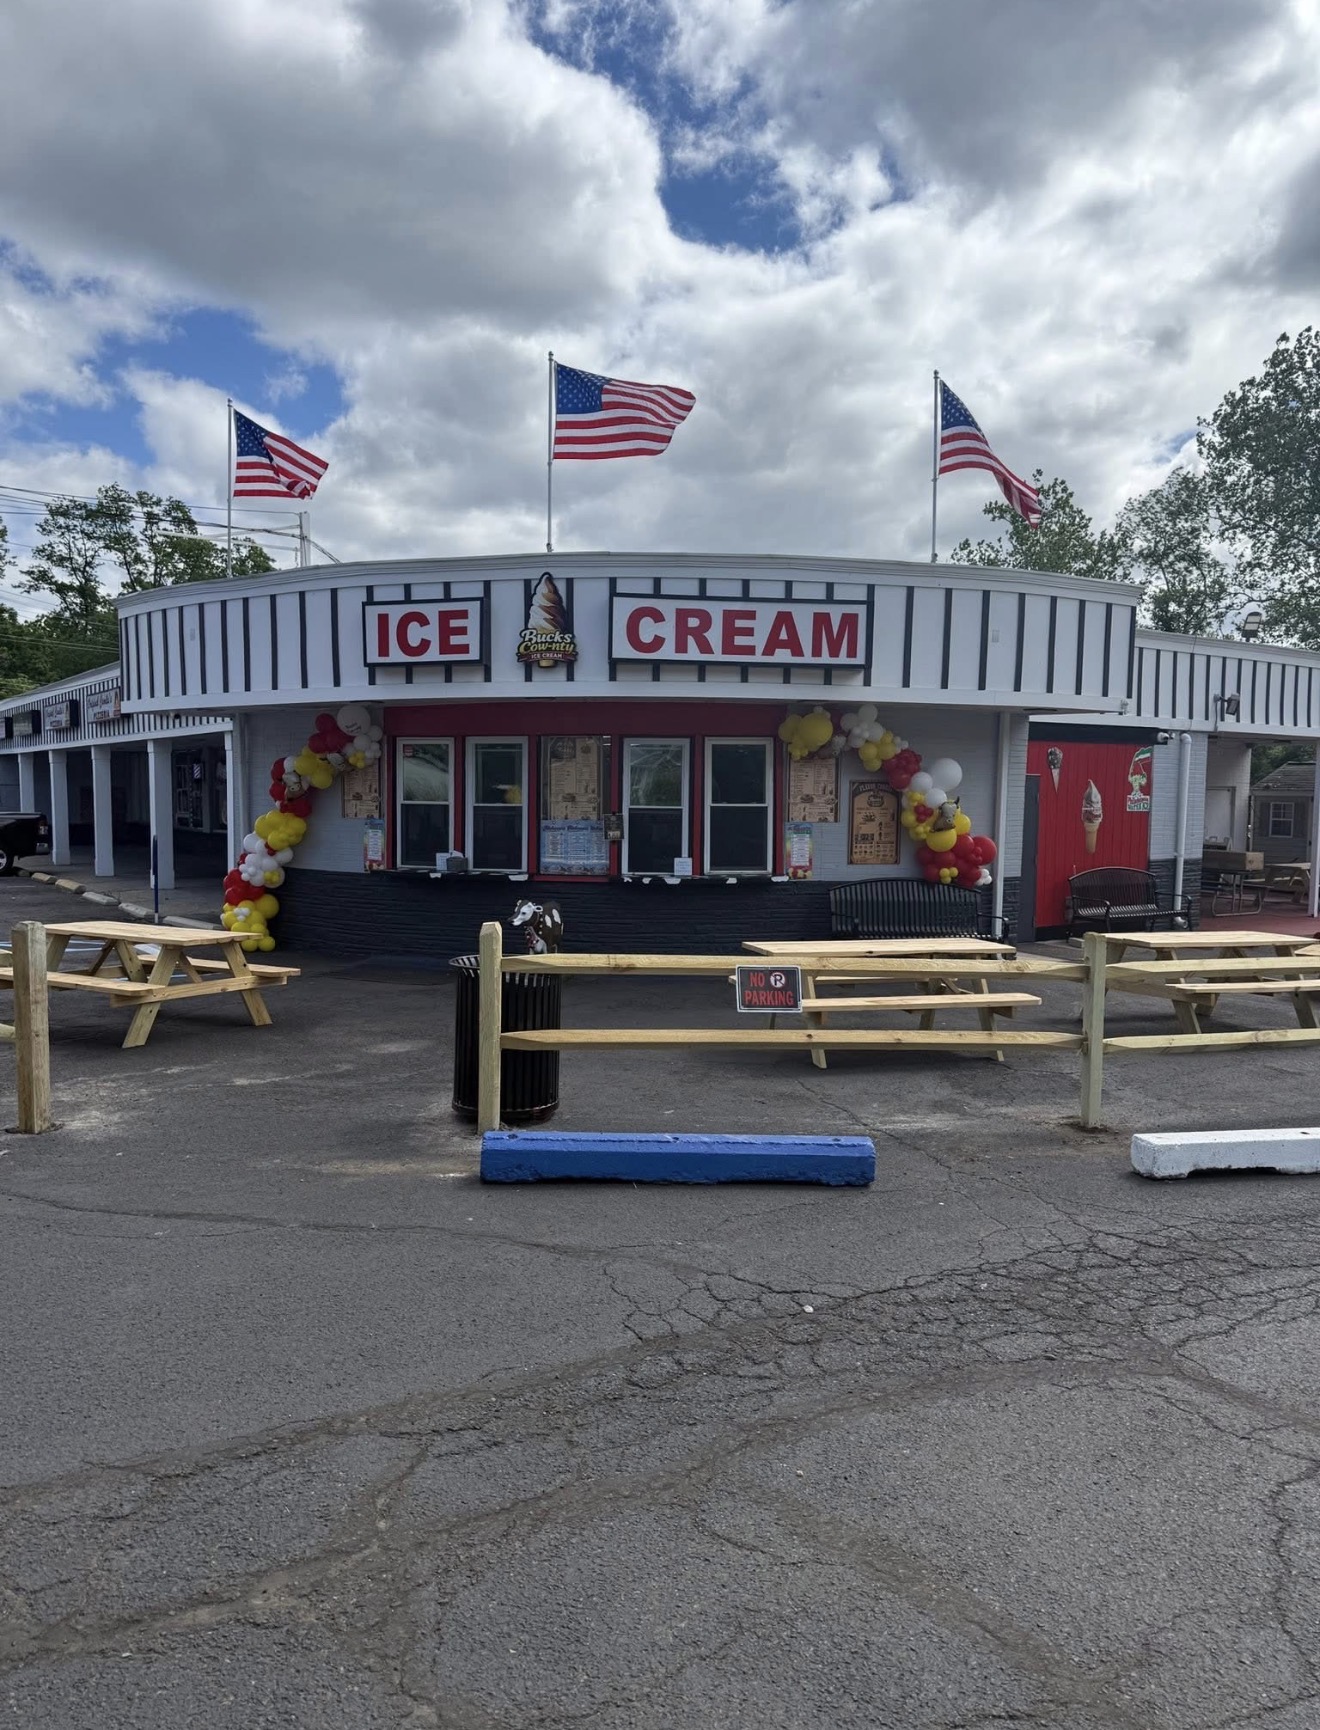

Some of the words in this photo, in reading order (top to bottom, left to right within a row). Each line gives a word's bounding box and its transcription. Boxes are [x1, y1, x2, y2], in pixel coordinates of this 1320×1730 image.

[377, 609, 470, 658] ICE
[626, 606, 860, 659] CREAM
[522, 630, 572, 643] Bucks
[750, 972, 765, 987] NO
[745, 991, 793, 1005] PARKING
